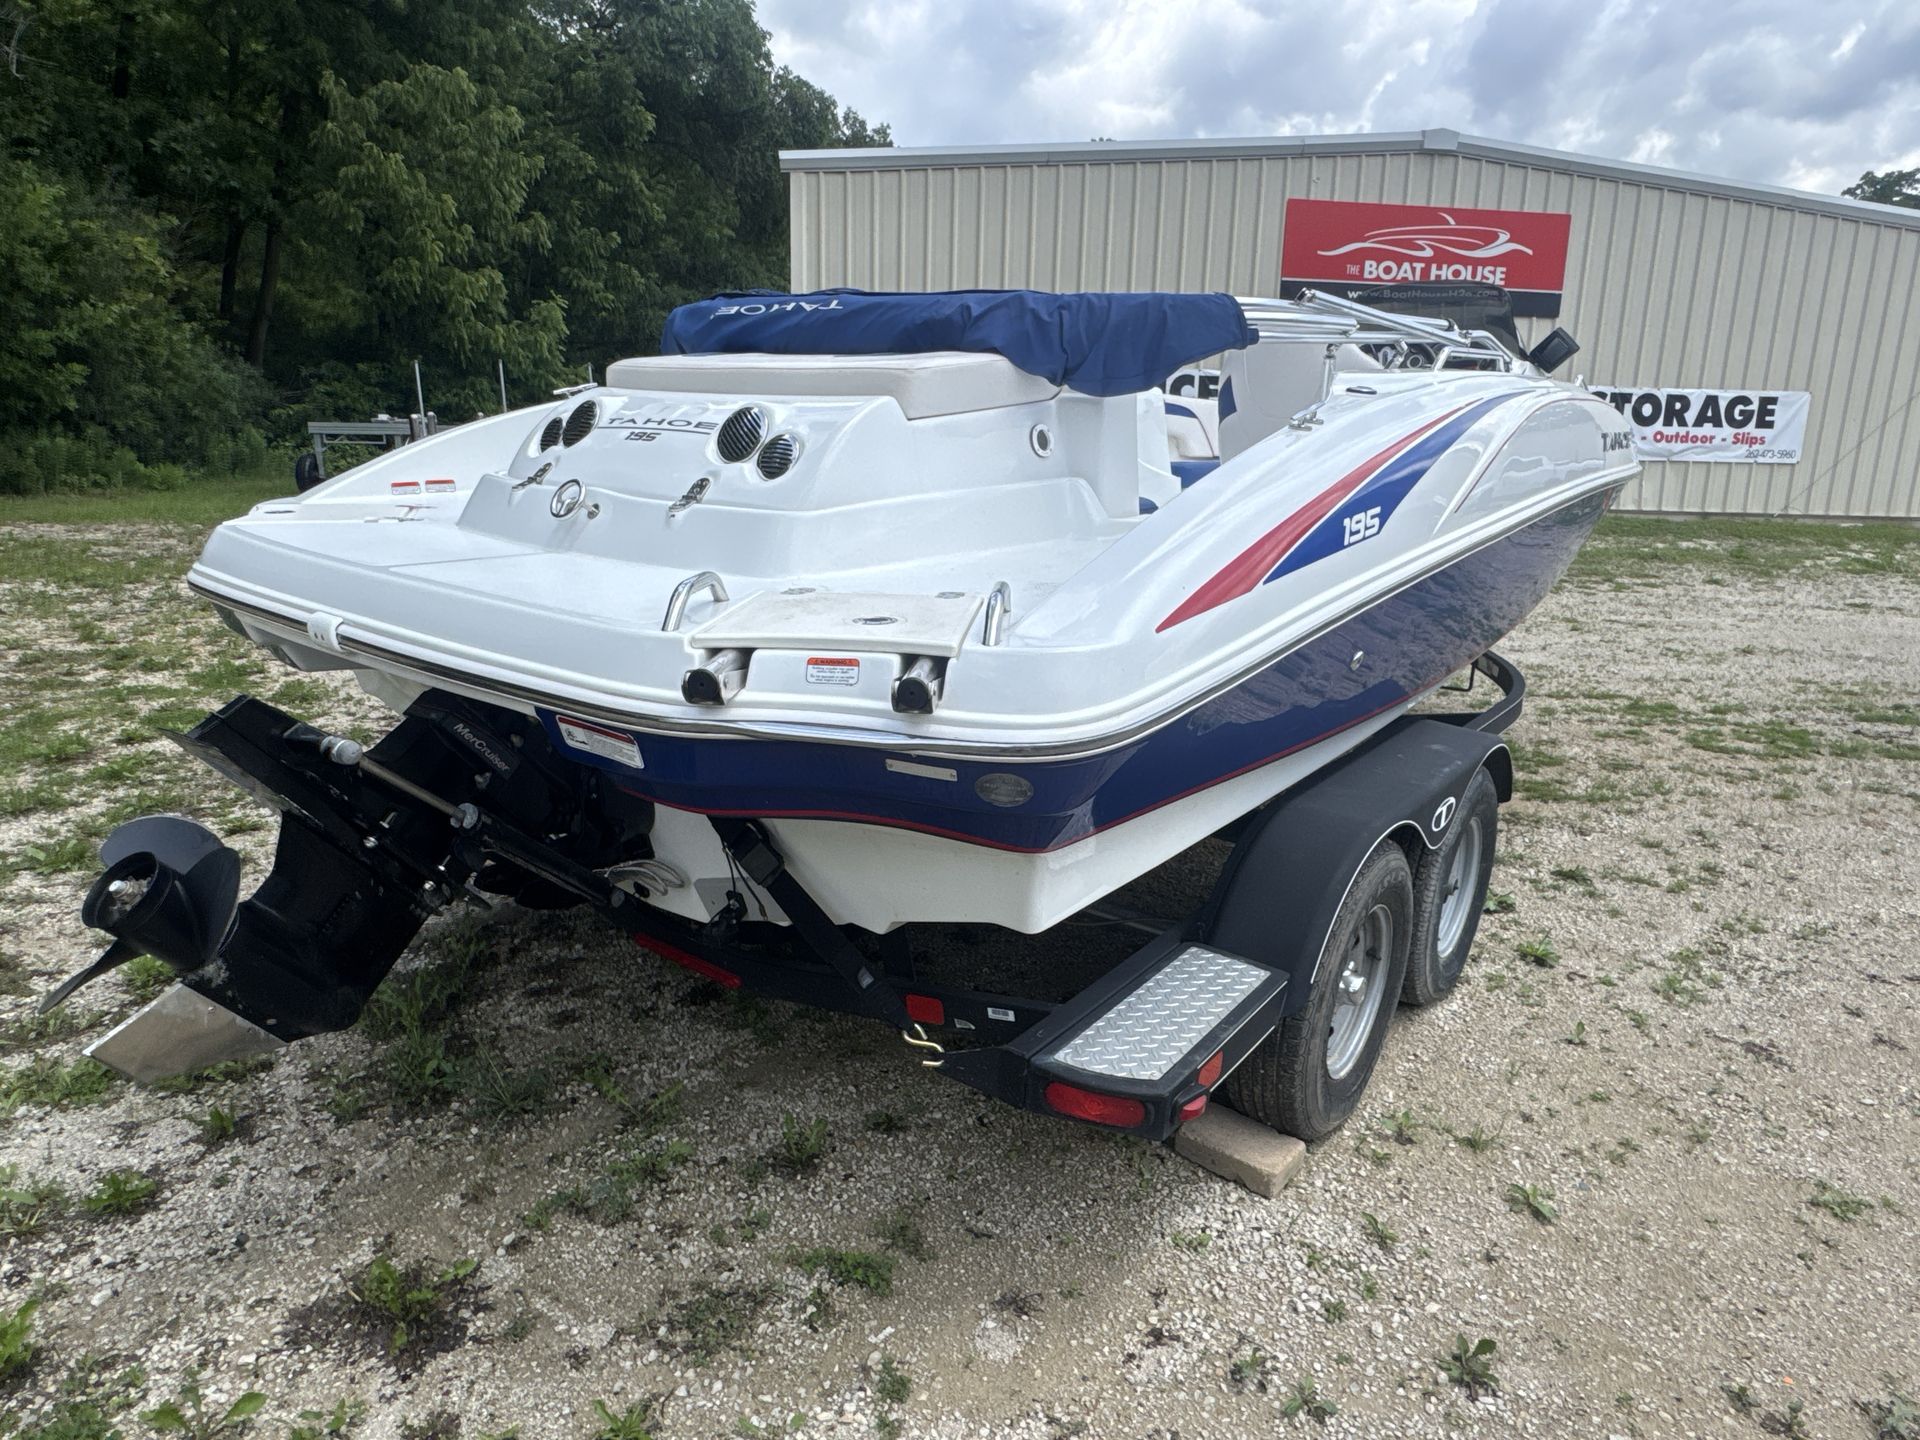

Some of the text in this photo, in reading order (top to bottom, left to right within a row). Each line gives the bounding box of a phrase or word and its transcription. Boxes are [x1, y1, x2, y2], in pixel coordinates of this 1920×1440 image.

[1346, 260, 1507, 286] THE BOAT HOUSE
[715, 299, 843, 315] TAHOE
[1591, 390, 1779, 429] TORAGE
[608, 417, 720, 431] TAHOE
[624, 431, 662, 442] 195
[1652, 430, 1716, 445] Outdoor
[1731, 431, 1767, 448] Slips
[1343, 506, 1381, 546] 195
[453, 722, 511, 772] MerCruiser
